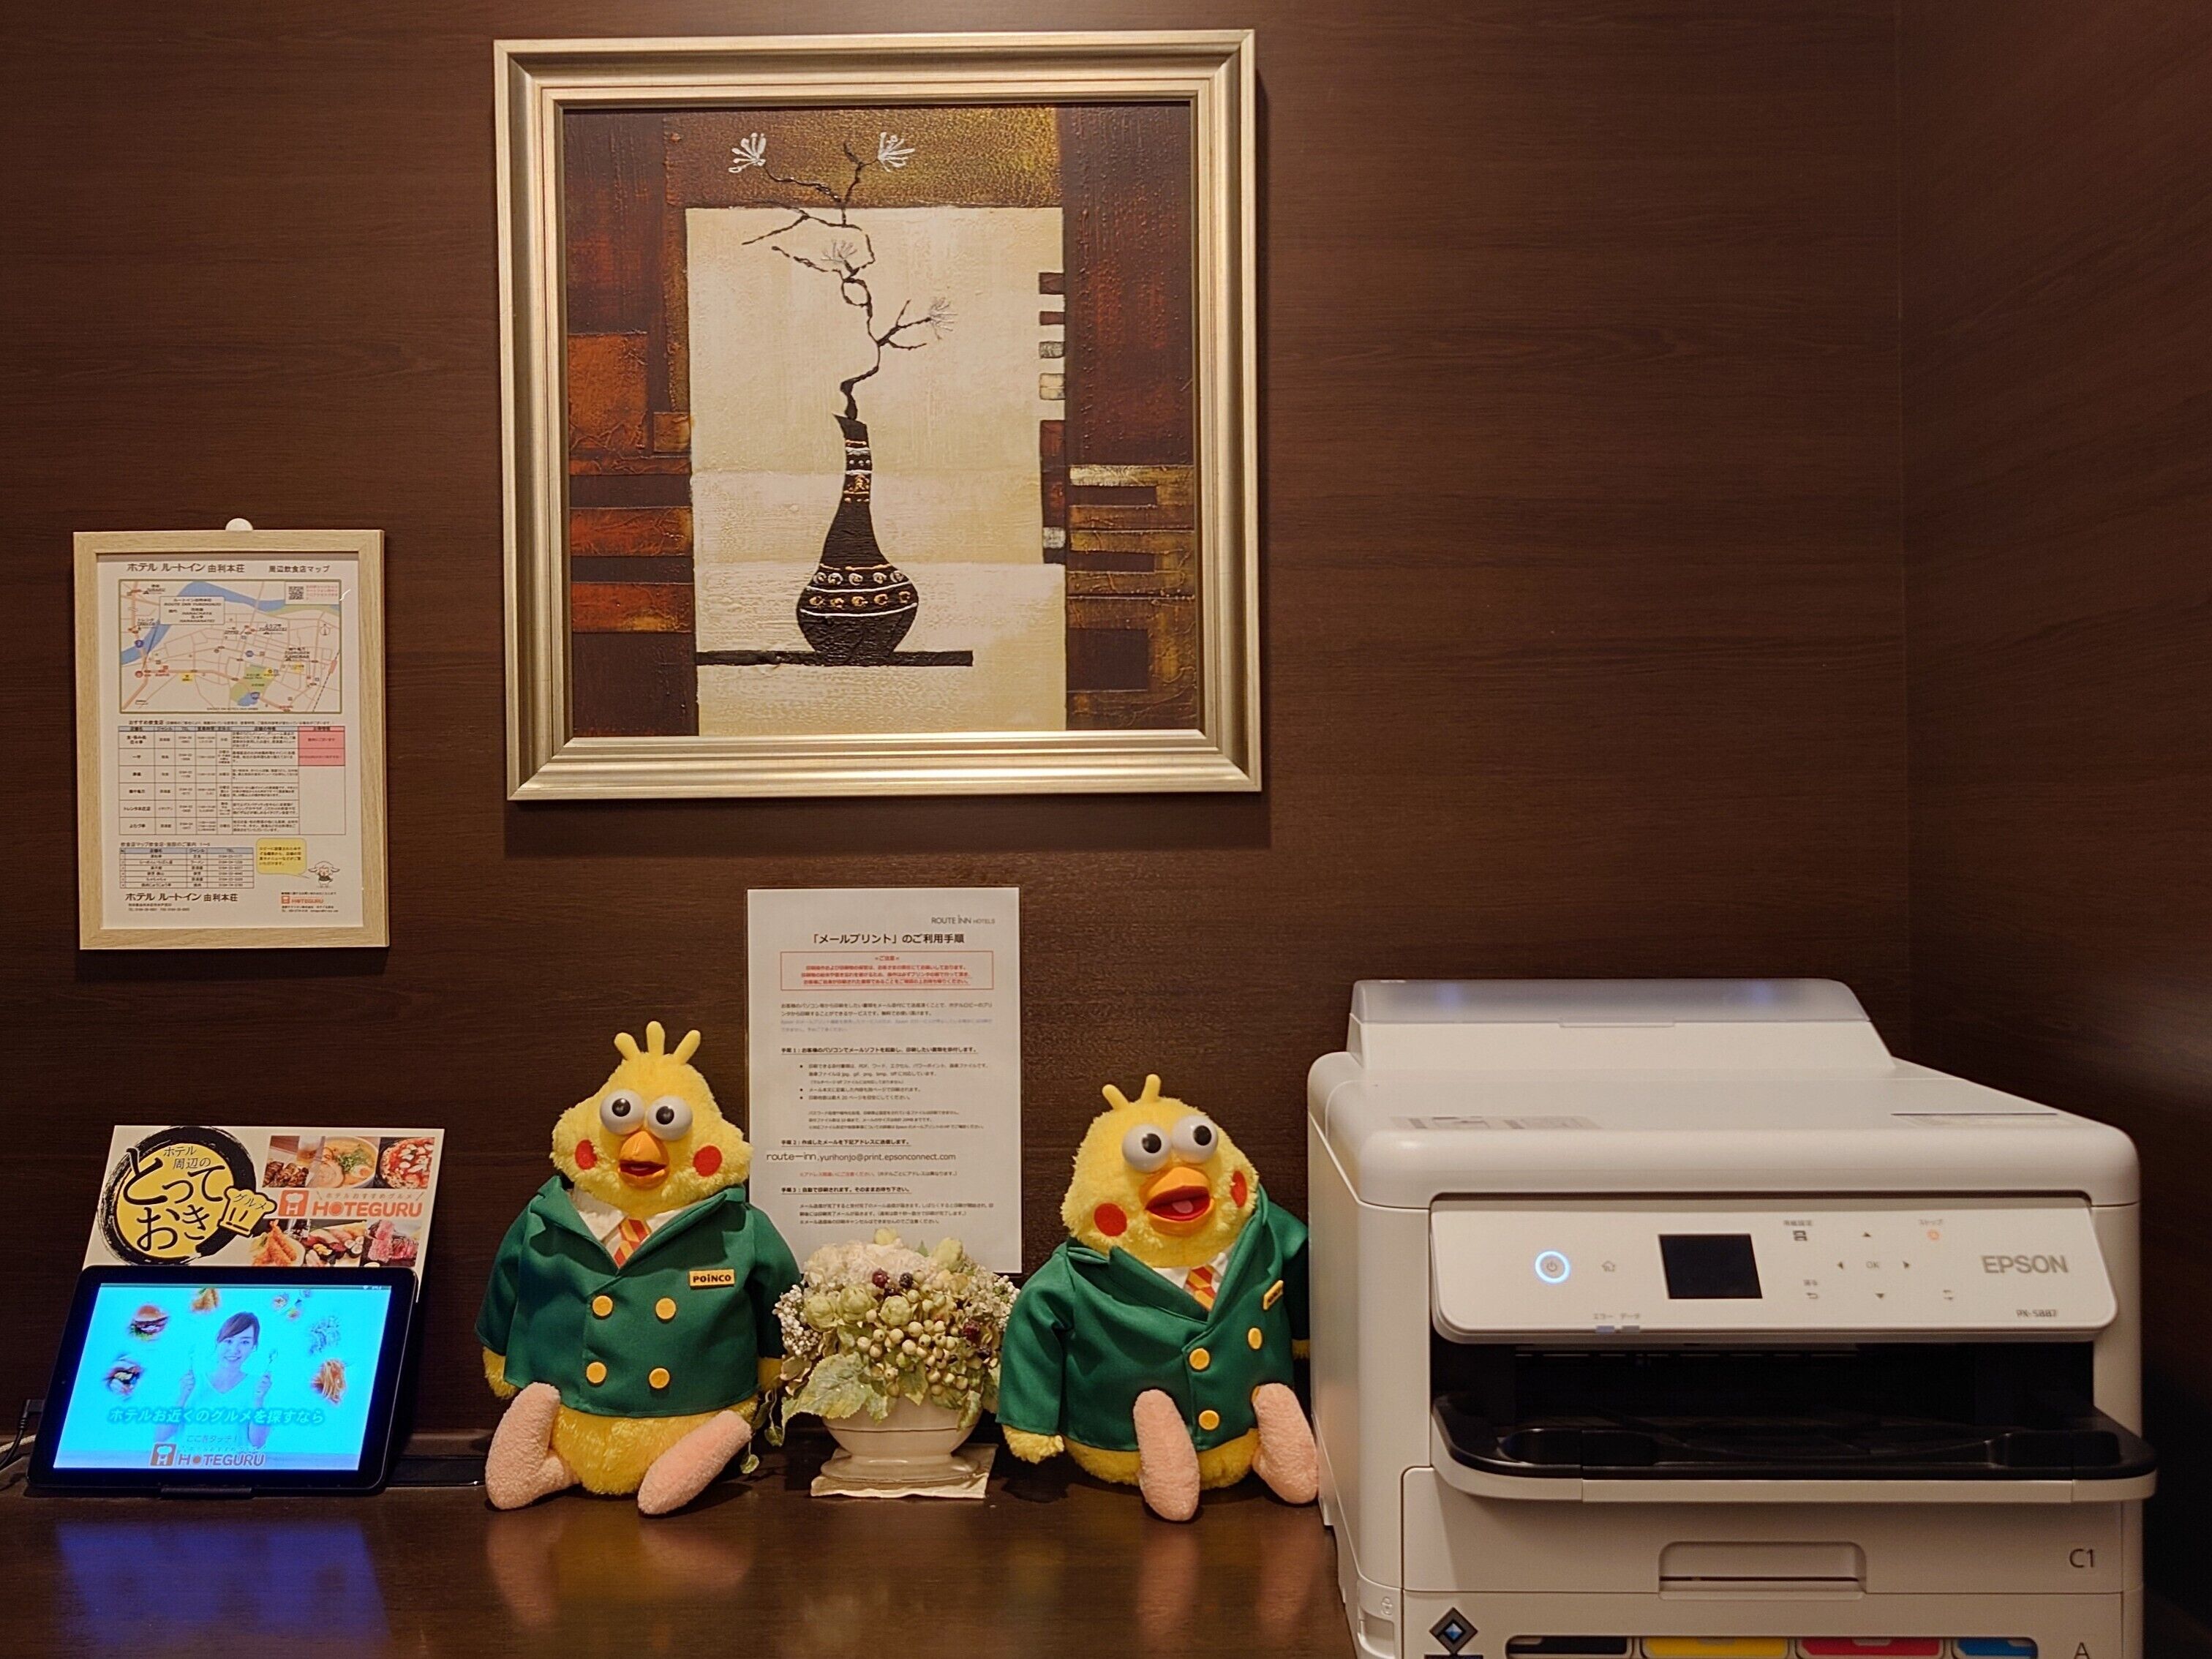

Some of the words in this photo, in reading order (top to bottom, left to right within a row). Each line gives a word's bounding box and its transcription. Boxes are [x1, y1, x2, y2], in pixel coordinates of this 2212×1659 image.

[127, 563, 158, 572] ホテル
[161, 563, 206, 572] ルートイン
[208, 563, 245, 573] 由利本荘
[125, 892, 155, 901] ホテル
[158, 892, 202, 901] ルートイン
[203, 893, 238, 902] 由利本荘
[931, 917, 957, 925] ROUTE
[813, 933, 965, 944] 「メールプリント」のご利用手順
[163, 1146, 198, 1156] ホテル
[172, 1157, 211, 1170] 周辺の
[123, 1147, 225, 1205] とって
[233, 1193, 268, 1211] グルメ
[312, 1201, 423, 1218] HOTEGURU
[136, 1204, 211, 1251] おき
[1865, 1260, 1880, 1269] OK
[1982, 1254, 2069, 1274] EPSON
[110, 1409, 325, 1423] ホテルお近くのグルメを探すなら
[2069, 1548, 2094, 1568] C1
[2074, 1641, 2091, 1659] A
